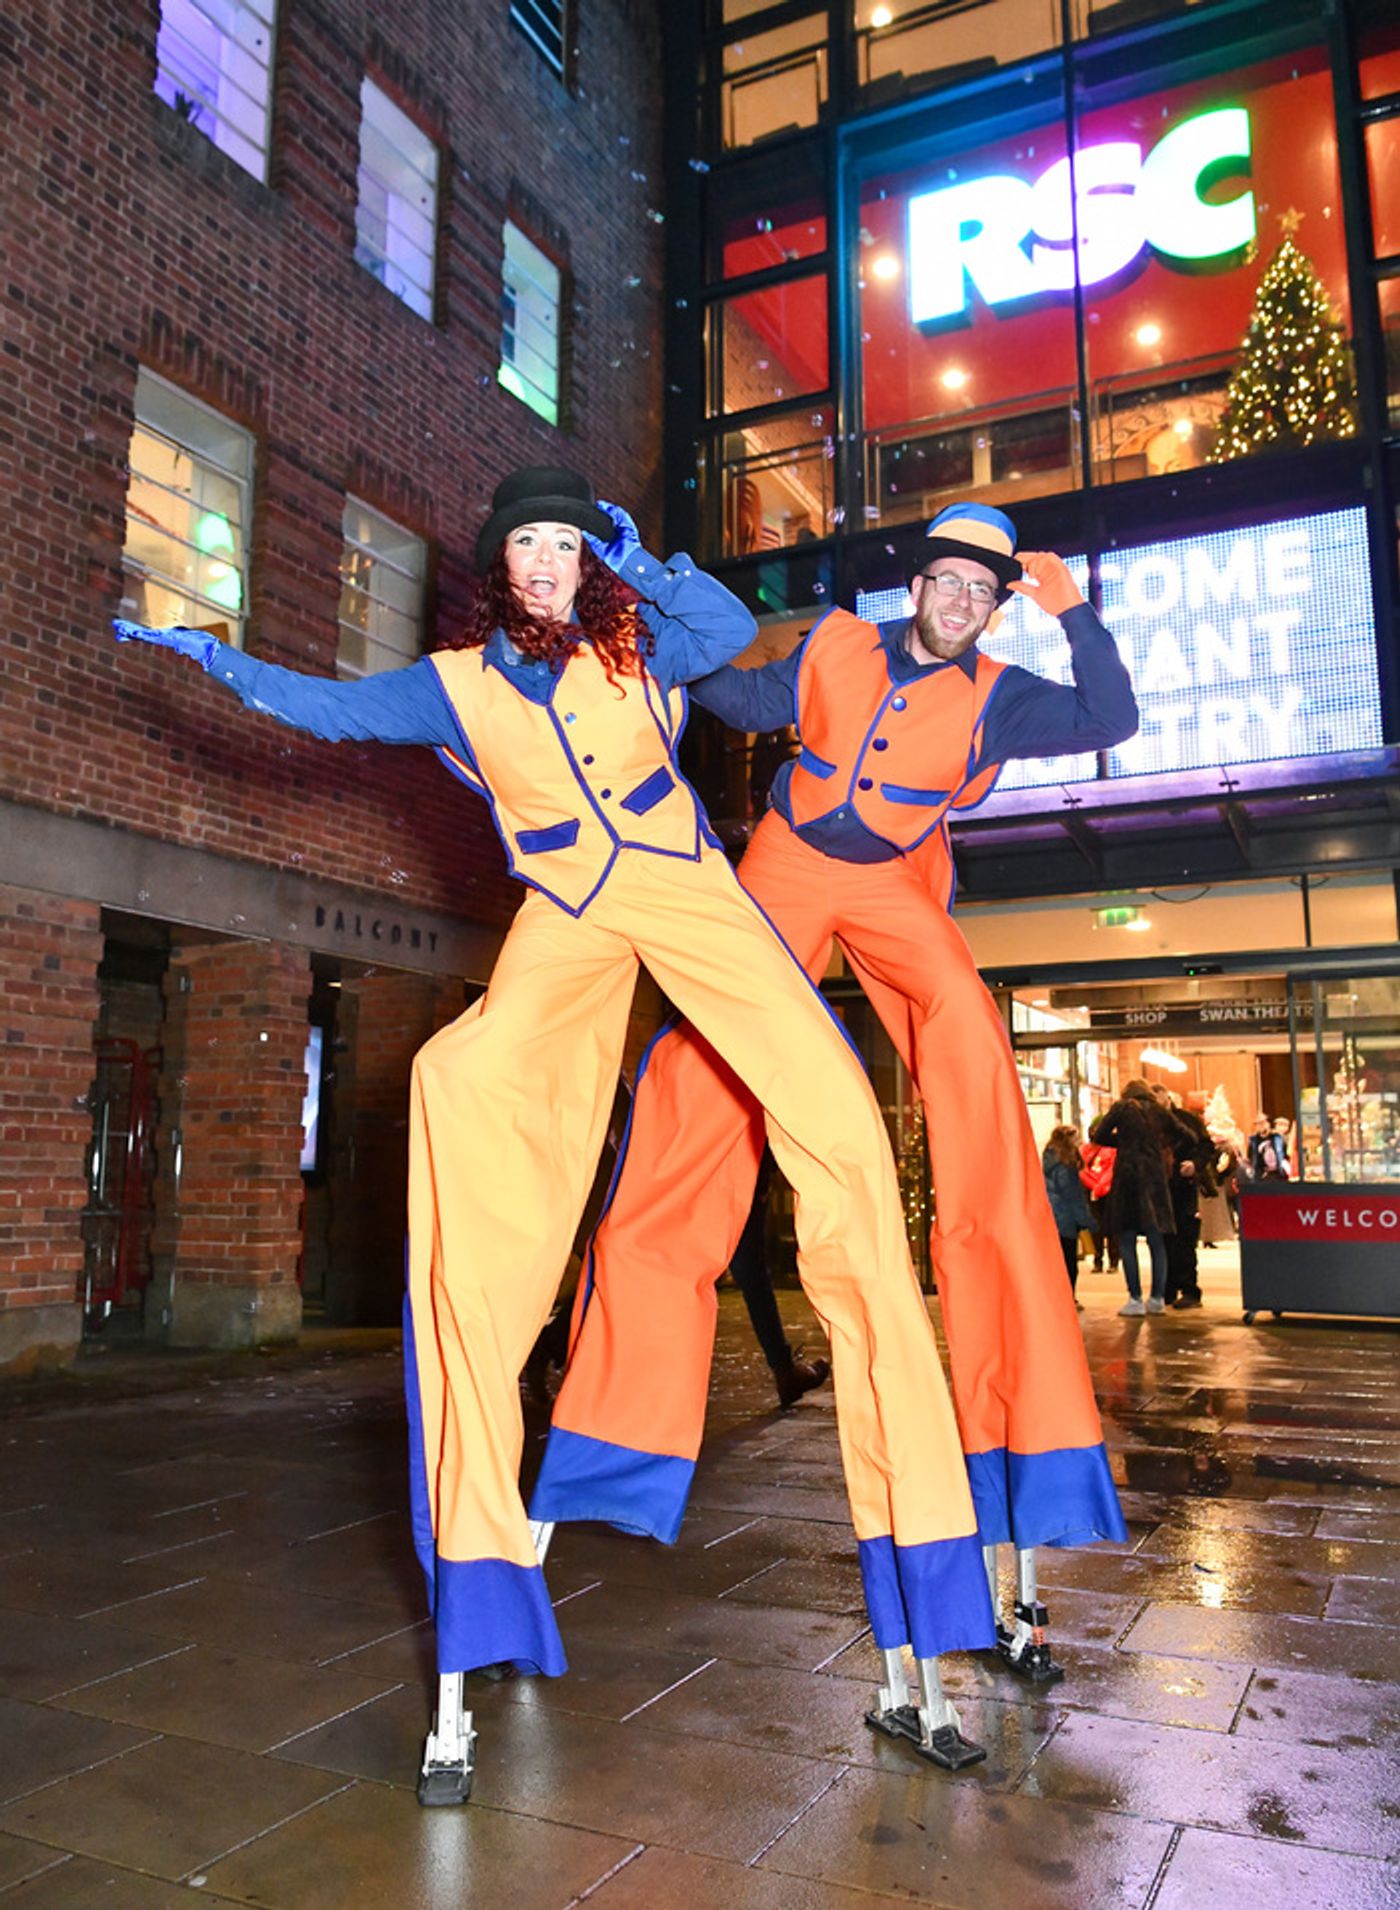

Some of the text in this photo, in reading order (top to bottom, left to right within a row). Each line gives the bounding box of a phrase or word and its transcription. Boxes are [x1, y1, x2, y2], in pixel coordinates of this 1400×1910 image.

[909, 107, 1257, 334] RSC
[315, 904, 438, 951] BALCONY
[1125, 1011, 1167, 1025] SHOP
[1200, 1005, 1315, 1022] SWAN THETR
[1297, 1209, 1398, 1228] WELCO
